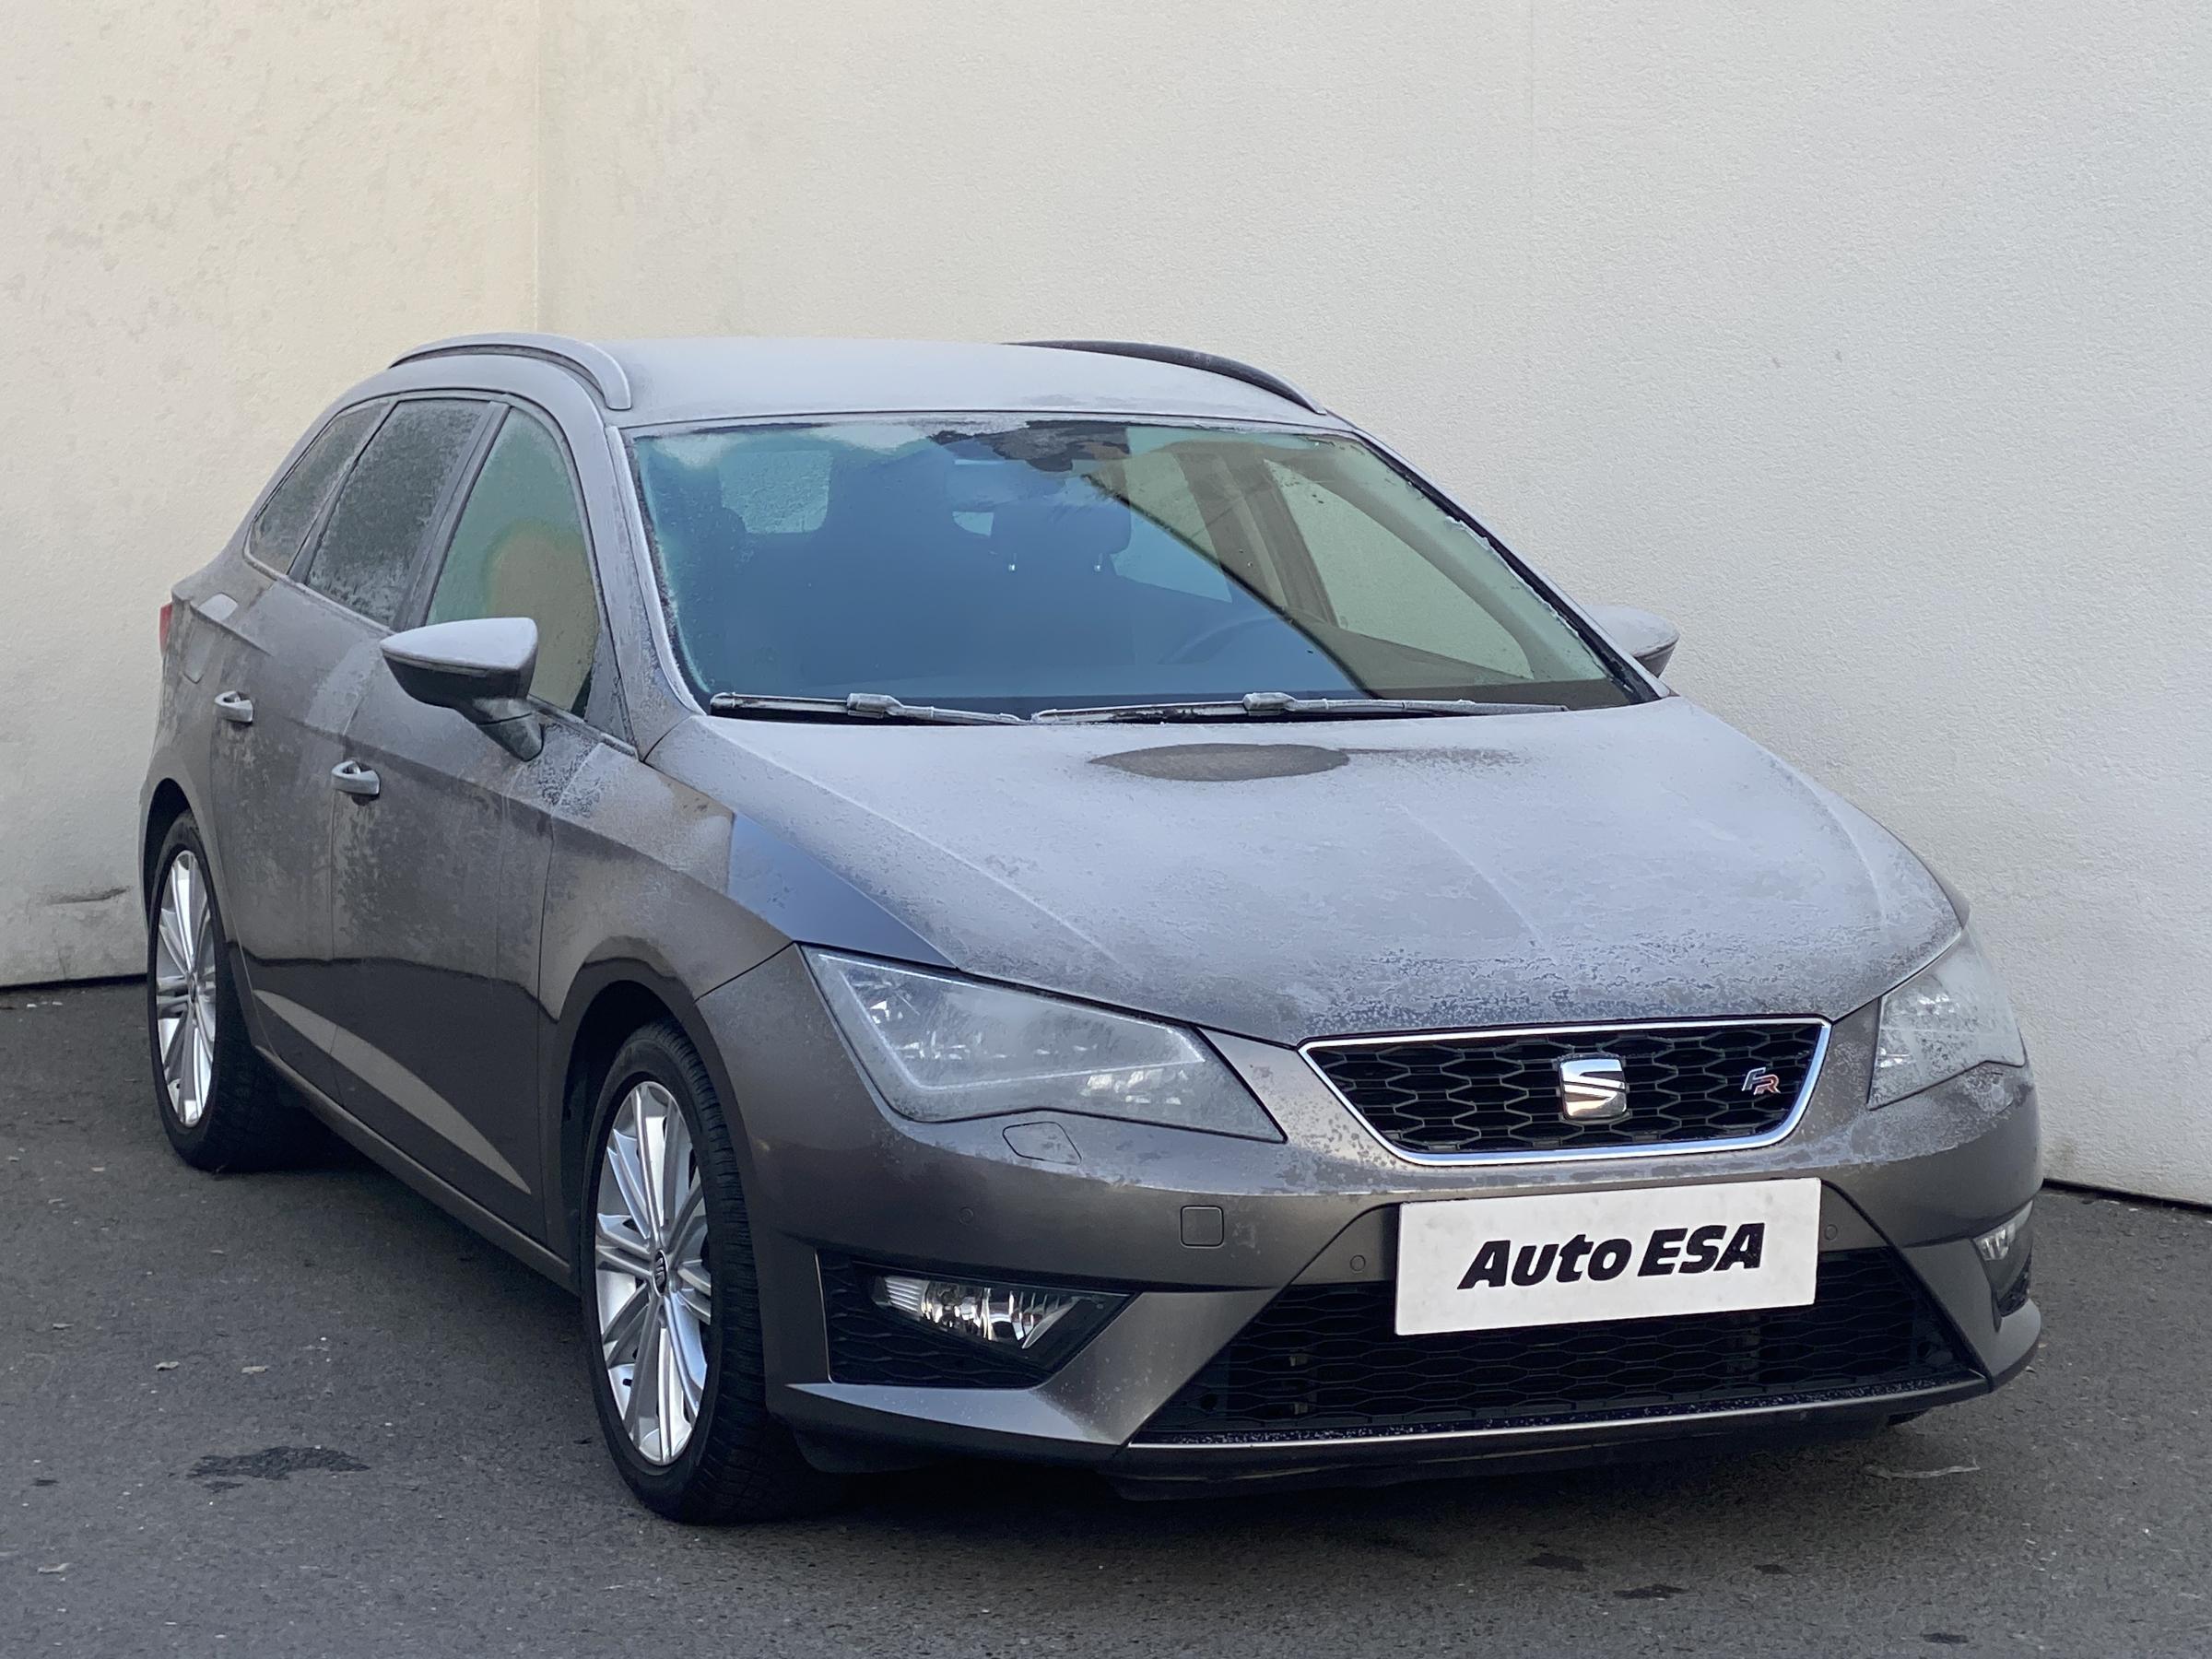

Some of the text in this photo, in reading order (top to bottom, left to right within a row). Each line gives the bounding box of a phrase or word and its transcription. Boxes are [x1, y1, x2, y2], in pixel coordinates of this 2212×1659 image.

[1741, 1066, 1782, 1095] FR
[1457, 1222, 1765, 1289] Auto ESA
